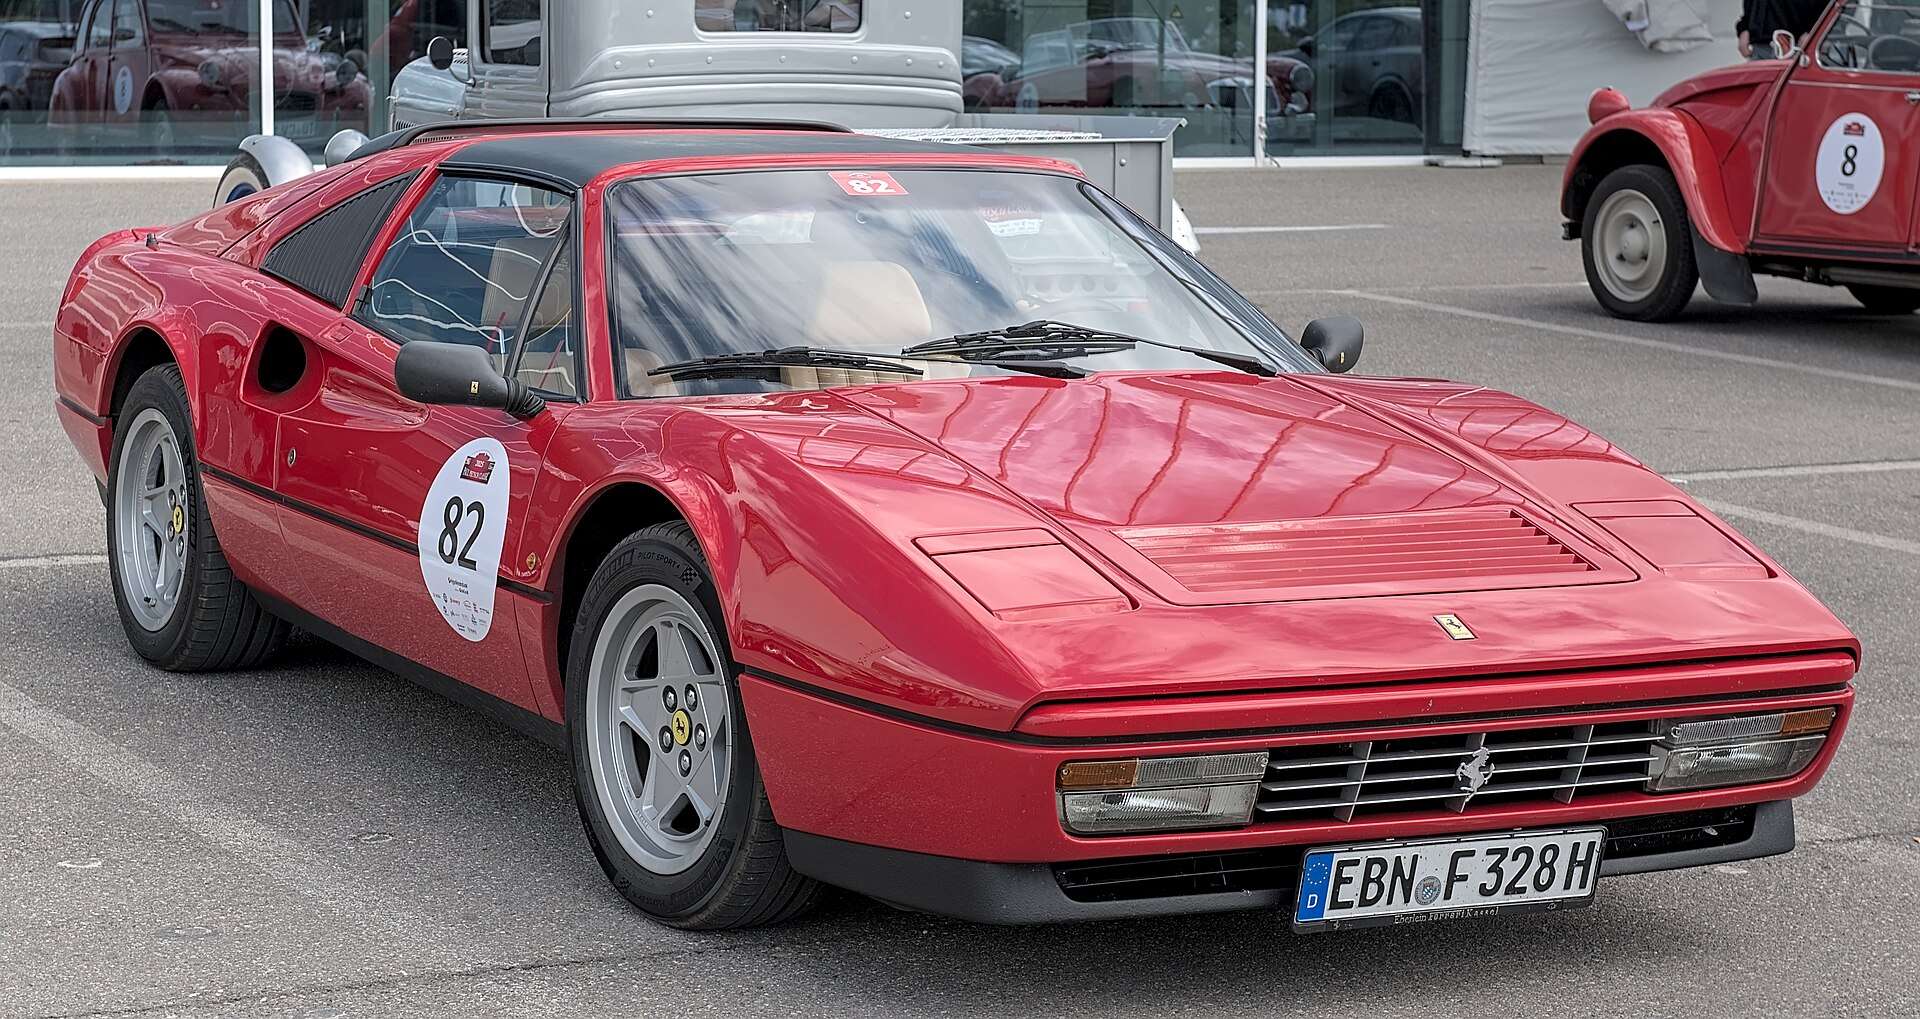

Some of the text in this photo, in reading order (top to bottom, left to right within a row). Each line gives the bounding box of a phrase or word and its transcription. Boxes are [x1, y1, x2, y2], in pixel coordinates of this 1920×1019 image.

[1842, 145, 1857, 176] 8
[848, 180, 896, 193] 82
[438, 496, 485, 571] 82
[656, 553, 676, 568] SPORT
[1329, 854, 1419, 910] EBN
[1443, 849, 1476, 900] F
[1307, 894, 1318, 908] D
